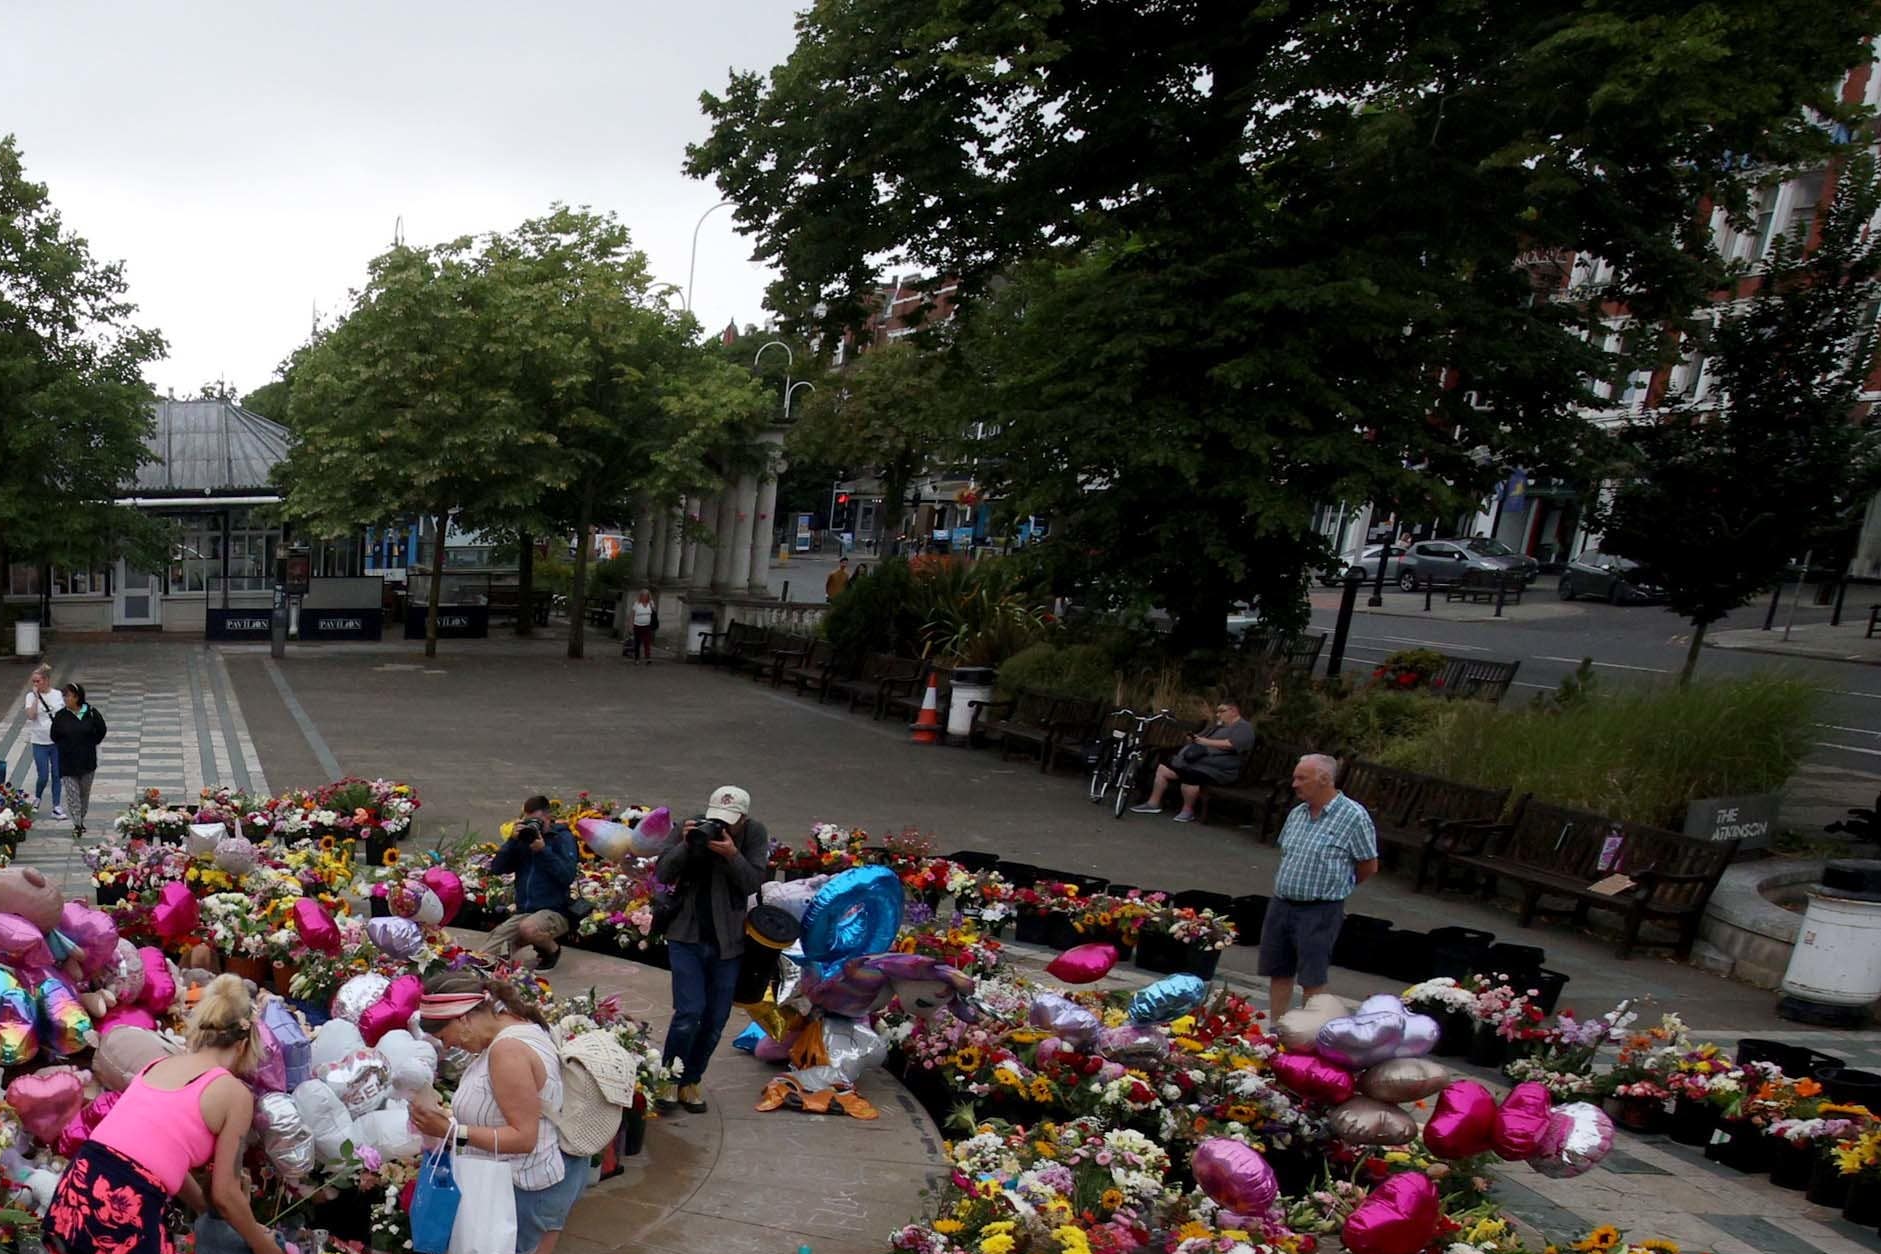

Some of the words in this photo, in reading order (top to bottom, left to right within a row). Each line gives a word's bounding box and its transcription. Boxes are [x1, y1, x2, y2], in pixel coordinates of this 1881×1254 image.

[226, 618, 269, 629] PAVILION
[319, 618, 362, 629] PAVILION
[1716, 807, 1739, 824] THE
[1712, 822, 1768, 840] ATKINSON
